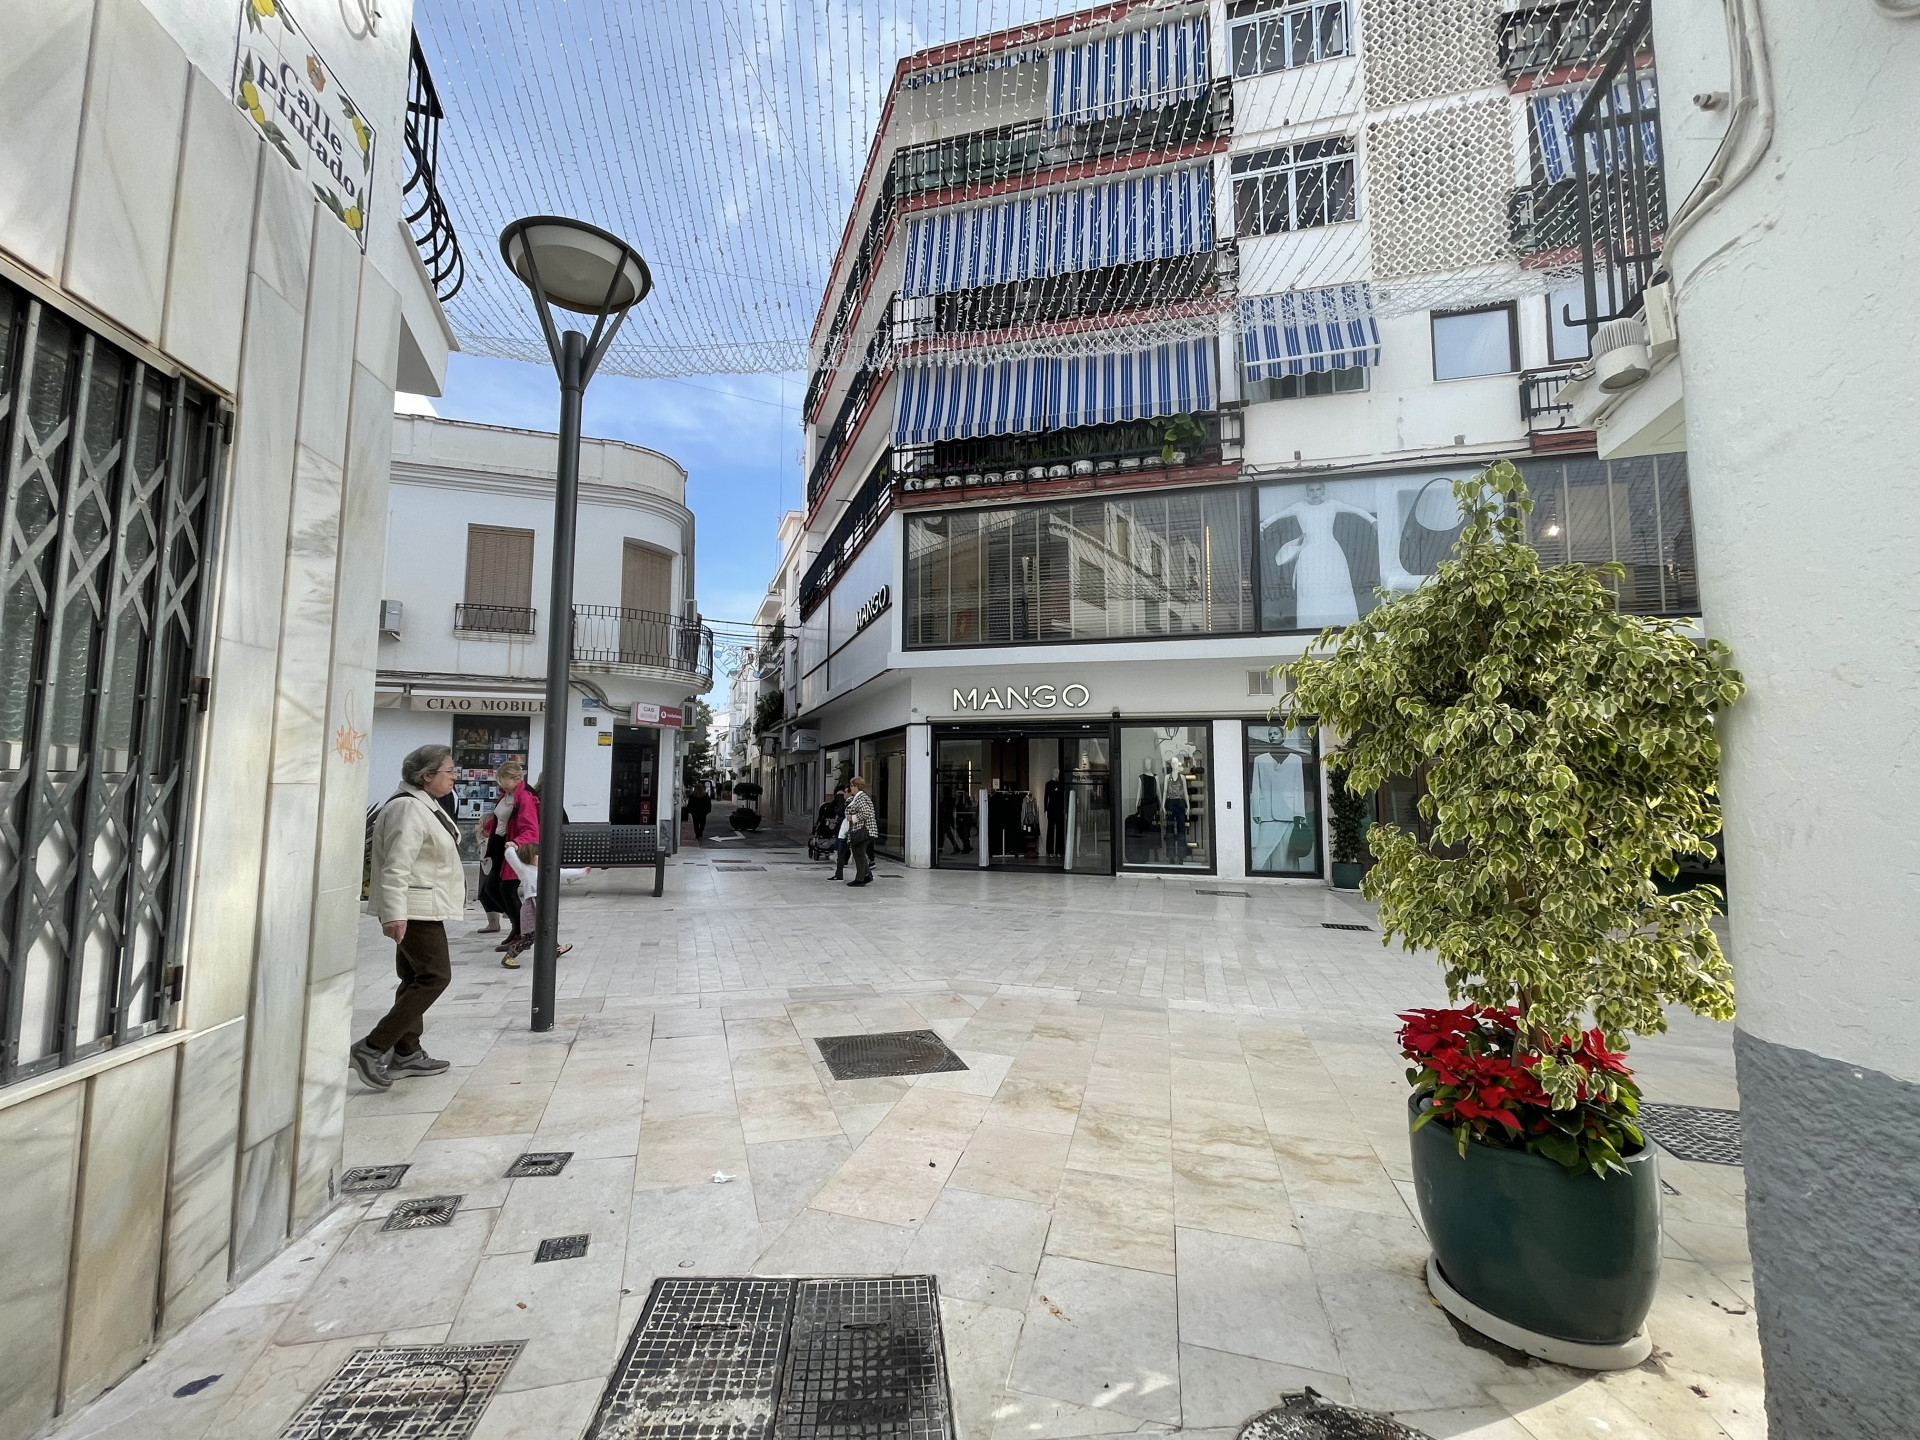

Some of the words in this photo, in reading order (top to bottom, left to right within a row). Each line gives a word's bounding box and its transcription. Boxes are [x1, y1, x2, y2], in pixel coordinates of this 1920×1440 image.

[257, 55, 355, 197] Pintado
[280, 62, 342, 156] Calle
[855, 584, 889, 631] MANGO
[426, 698, 471, 710] CIAO
[953, 684, 1090, 711] MANGO
